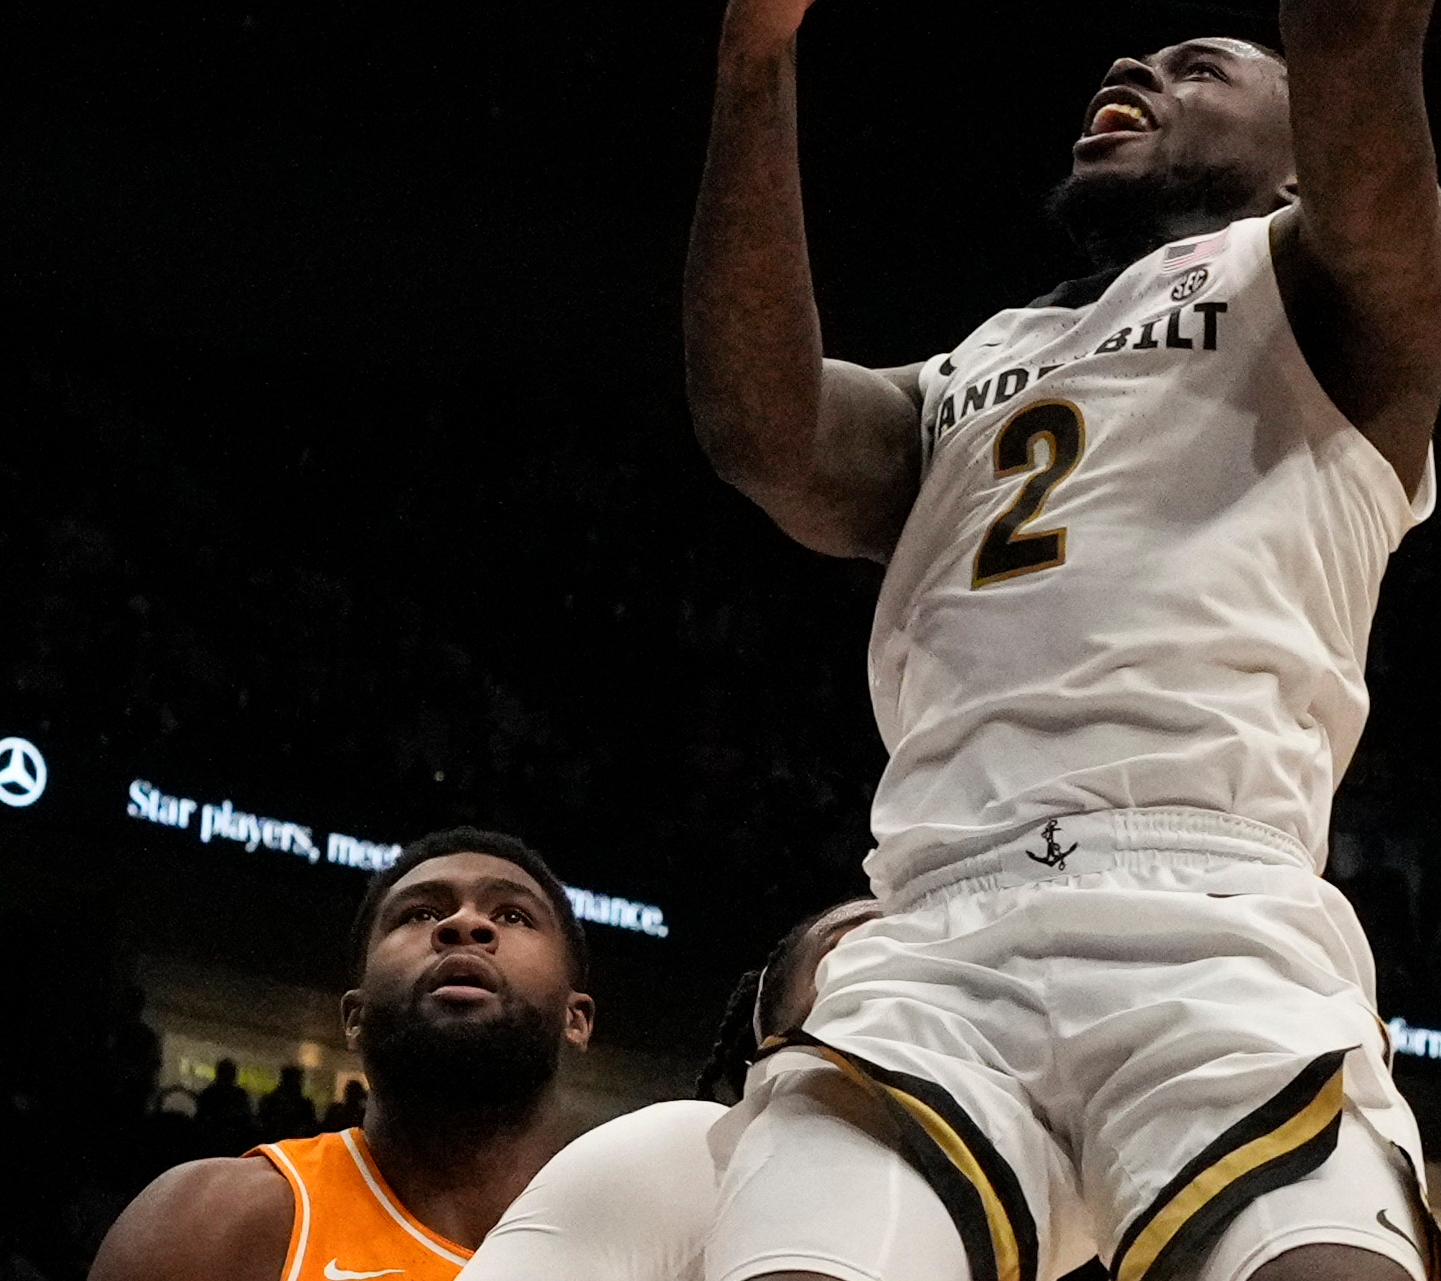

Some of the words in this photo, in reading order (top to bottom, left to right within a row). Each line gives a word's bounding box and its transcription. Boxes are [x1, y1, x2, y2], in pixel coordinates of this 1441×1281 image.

[969, 398, 1085, 591] 2
[126, 777, 198, 830] Star
[199, 798, 321, 866] players,
